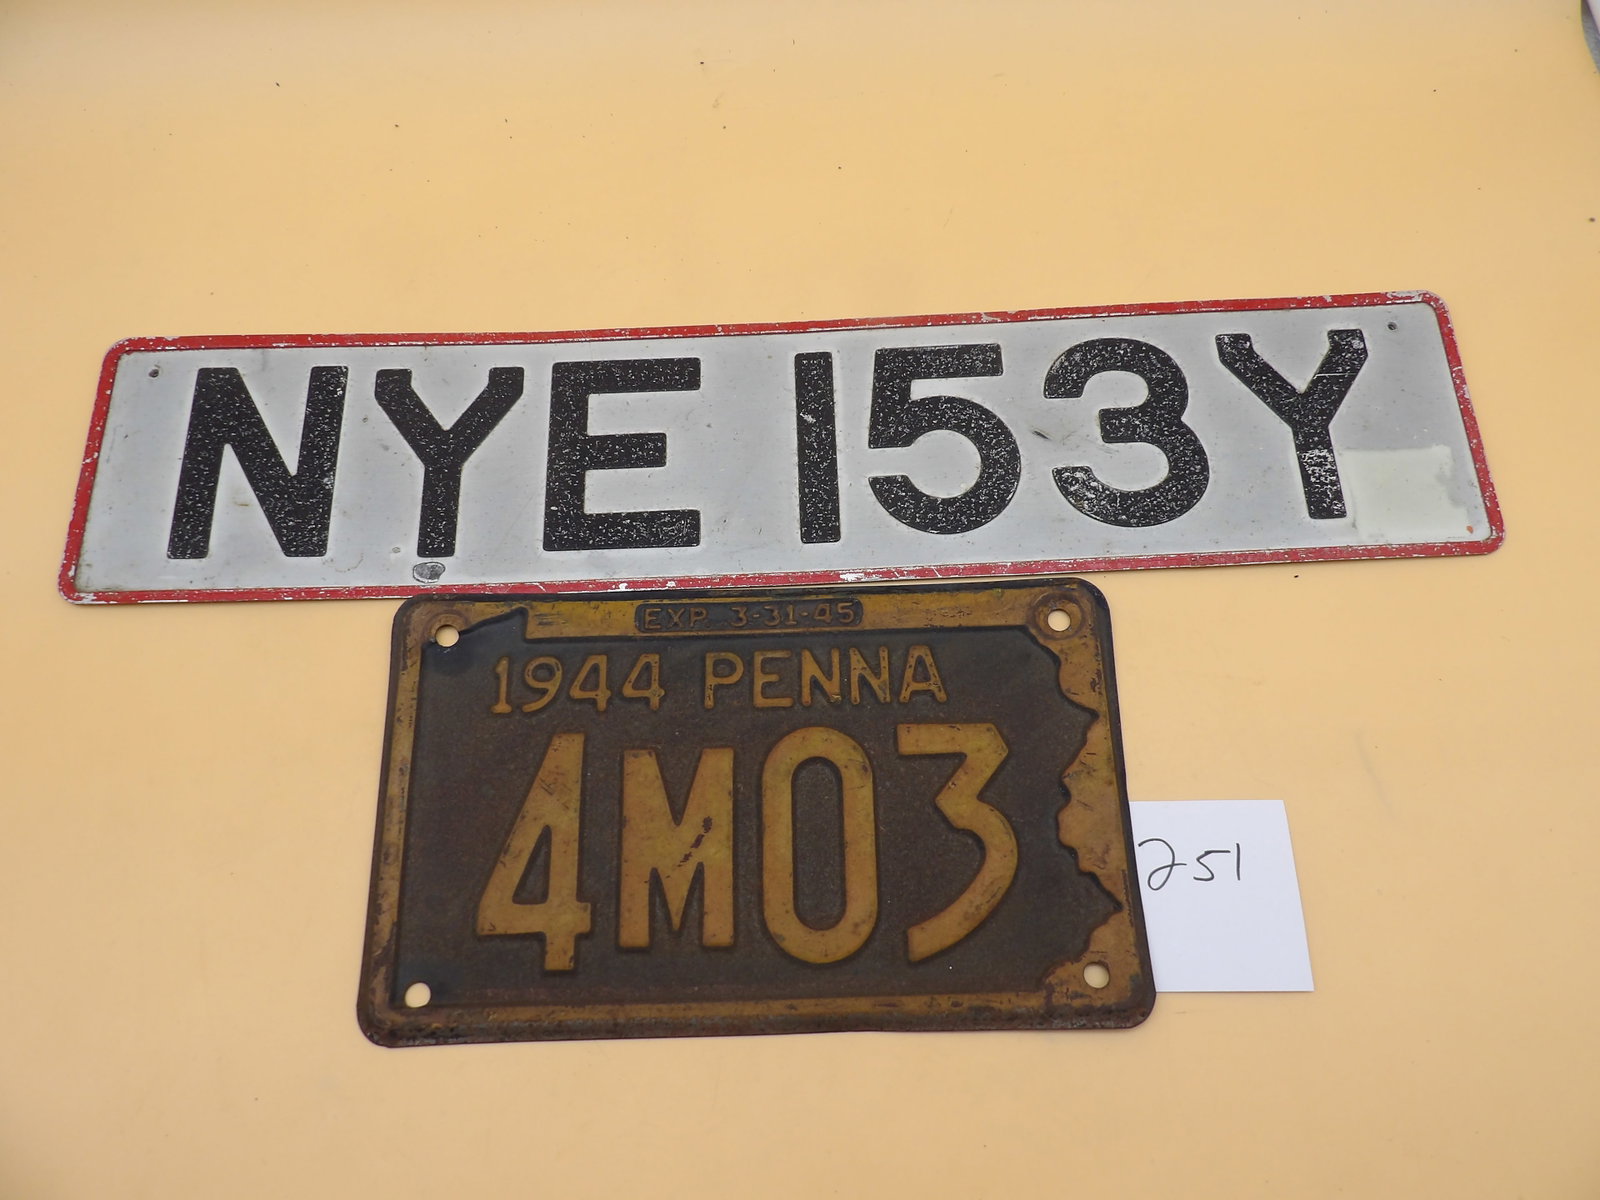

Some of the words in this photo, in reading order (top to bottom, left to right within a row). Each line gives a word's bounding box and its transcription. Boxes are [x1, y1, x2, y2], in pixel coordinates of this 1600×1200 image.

[166, 356, 702, 560] NYE
[793, 328, 1369, 544] 153Y
[730, 600, 856, 629] 3-31-45
[490, 653, 667, 716] 1944
[703, 645, 948, 711] PENNA
[1137, 837, 1241, 891] 251
